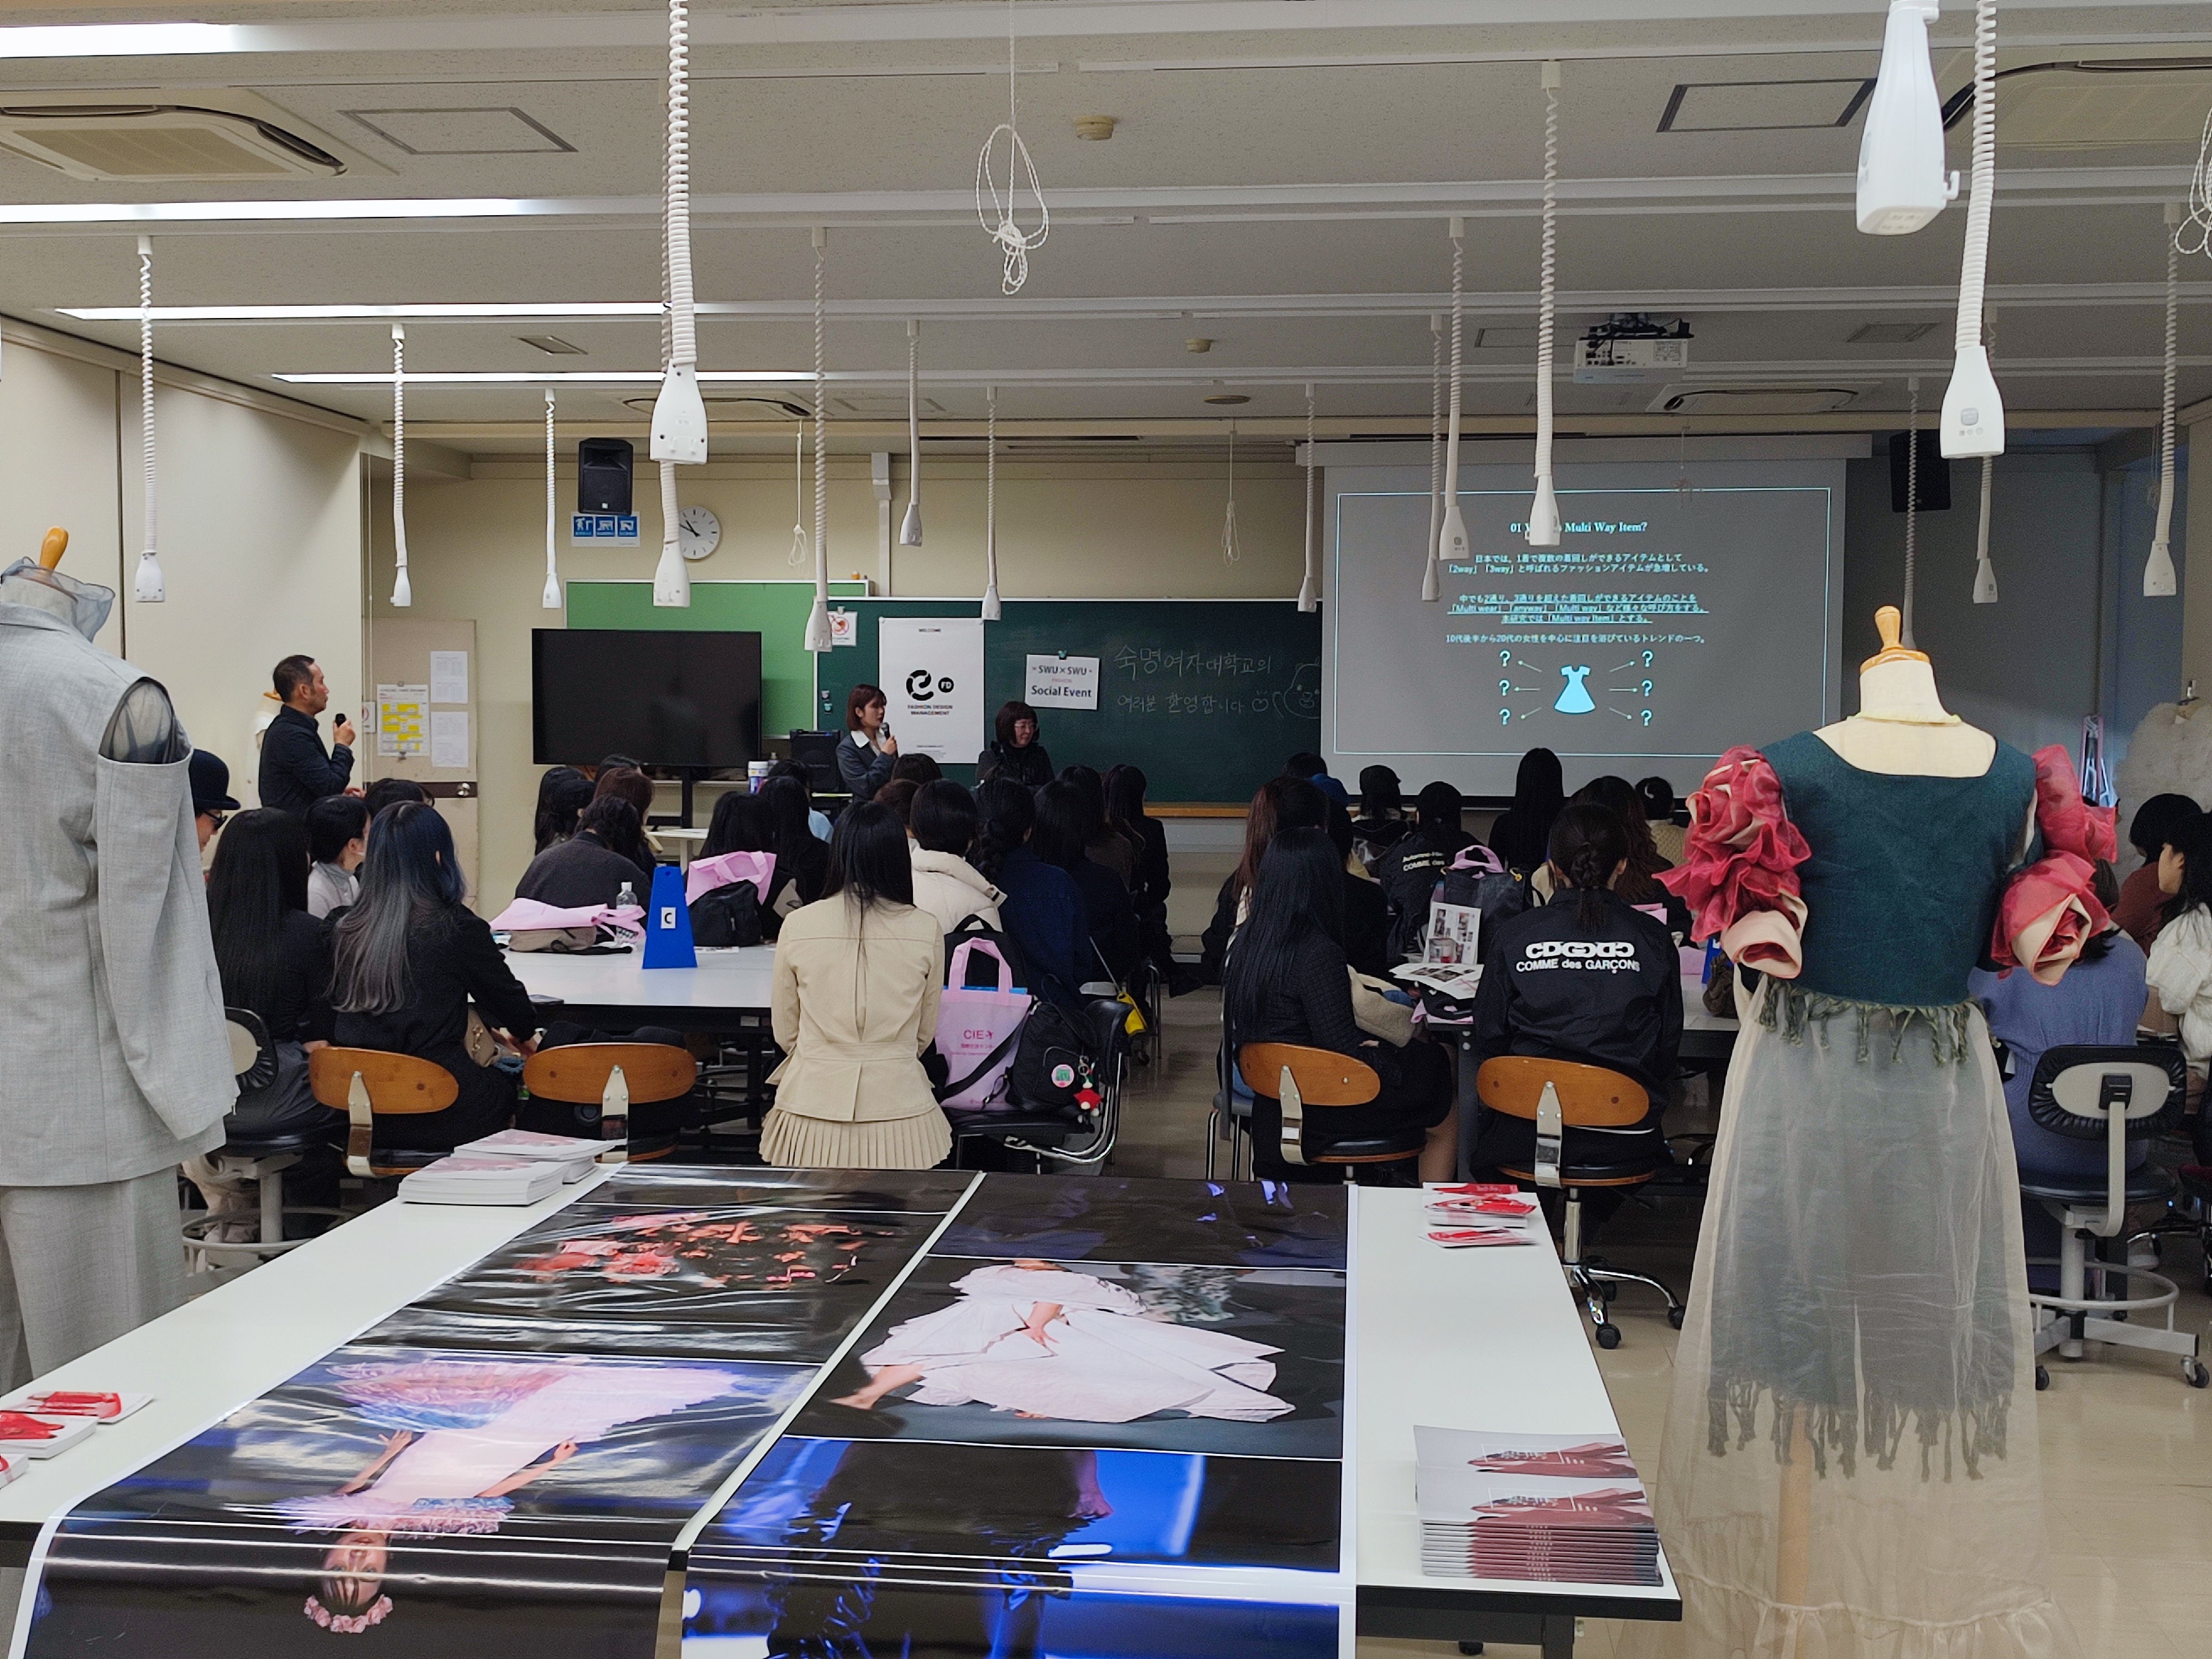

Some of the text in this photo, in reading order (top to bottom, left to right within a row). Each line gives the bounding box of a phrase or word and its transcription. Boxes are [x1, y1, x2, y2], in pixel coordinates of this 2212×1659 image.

[1510, 523, 1522, 533] 01
[1564, 522, 1592, 533] Multi
[1594, 521, 1616, 535] Way
[1619, 521, 1647, 533] Item?
[1039, 665, 1058, 674] SWU
[1067, 666, 1087, 675] SWU
[1031, 685, 1092, 697] Social Event
[1117, 694, 1157, 713] 여러분
[665, 912, 672, 924] C
[1516, 958, 1640, 974] COMME des GARÇONS
[963, 1030, 984, 1040] CIE
